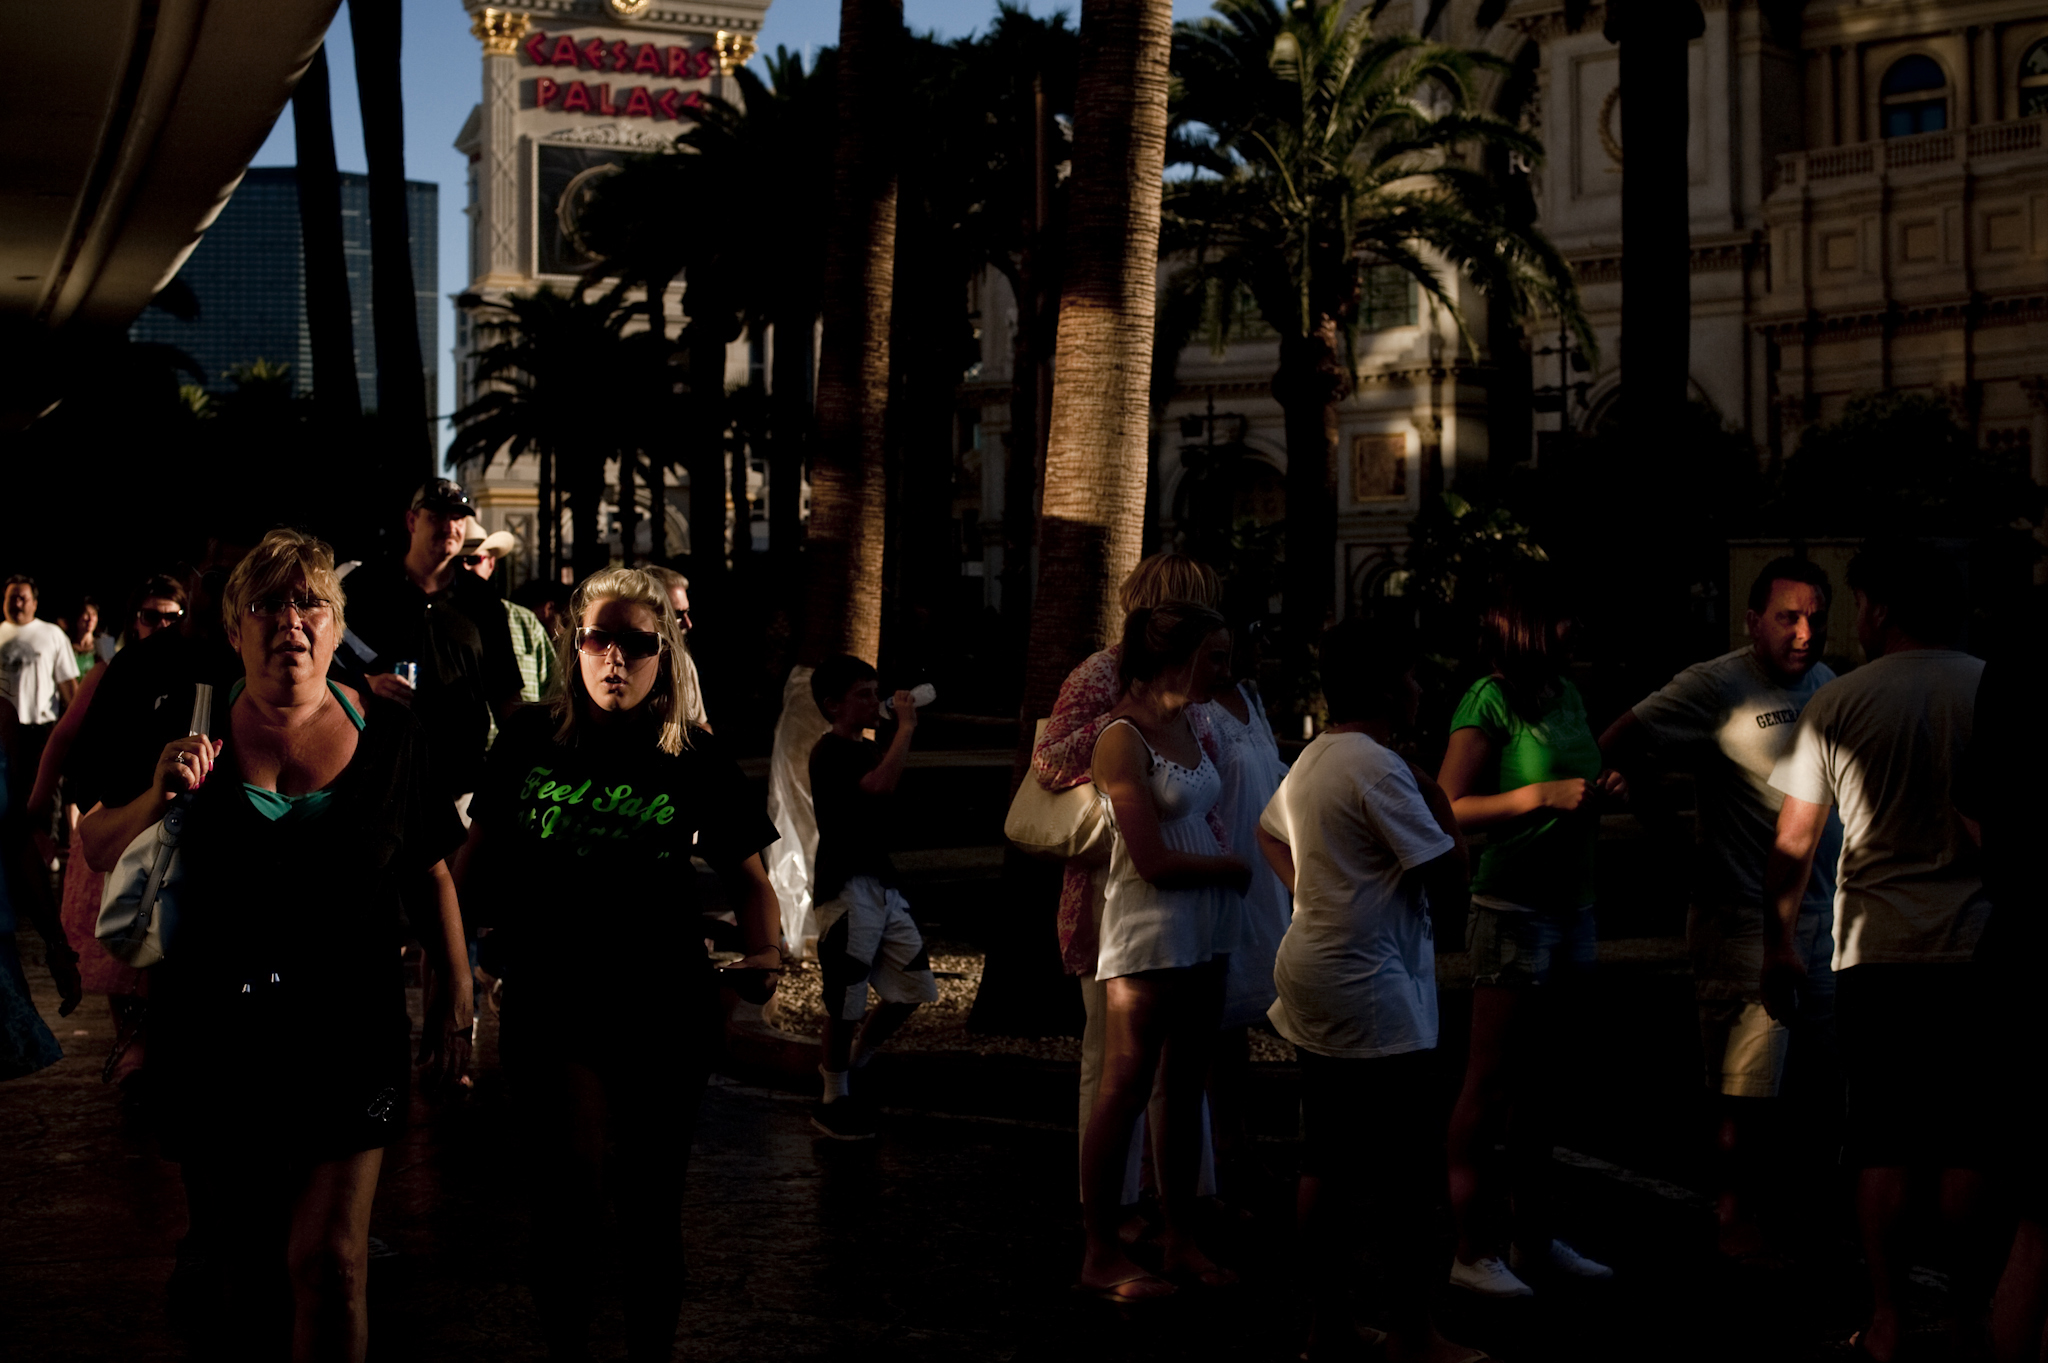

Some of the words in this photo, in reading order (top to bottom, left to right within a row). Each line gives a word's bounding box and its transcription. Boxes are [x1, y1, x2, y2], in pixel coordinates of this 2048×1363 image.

[525, 31, 713, 79] CAESARS
[520, 766, 592, 804] Feel
[592, 785, 675, 830] Safe
